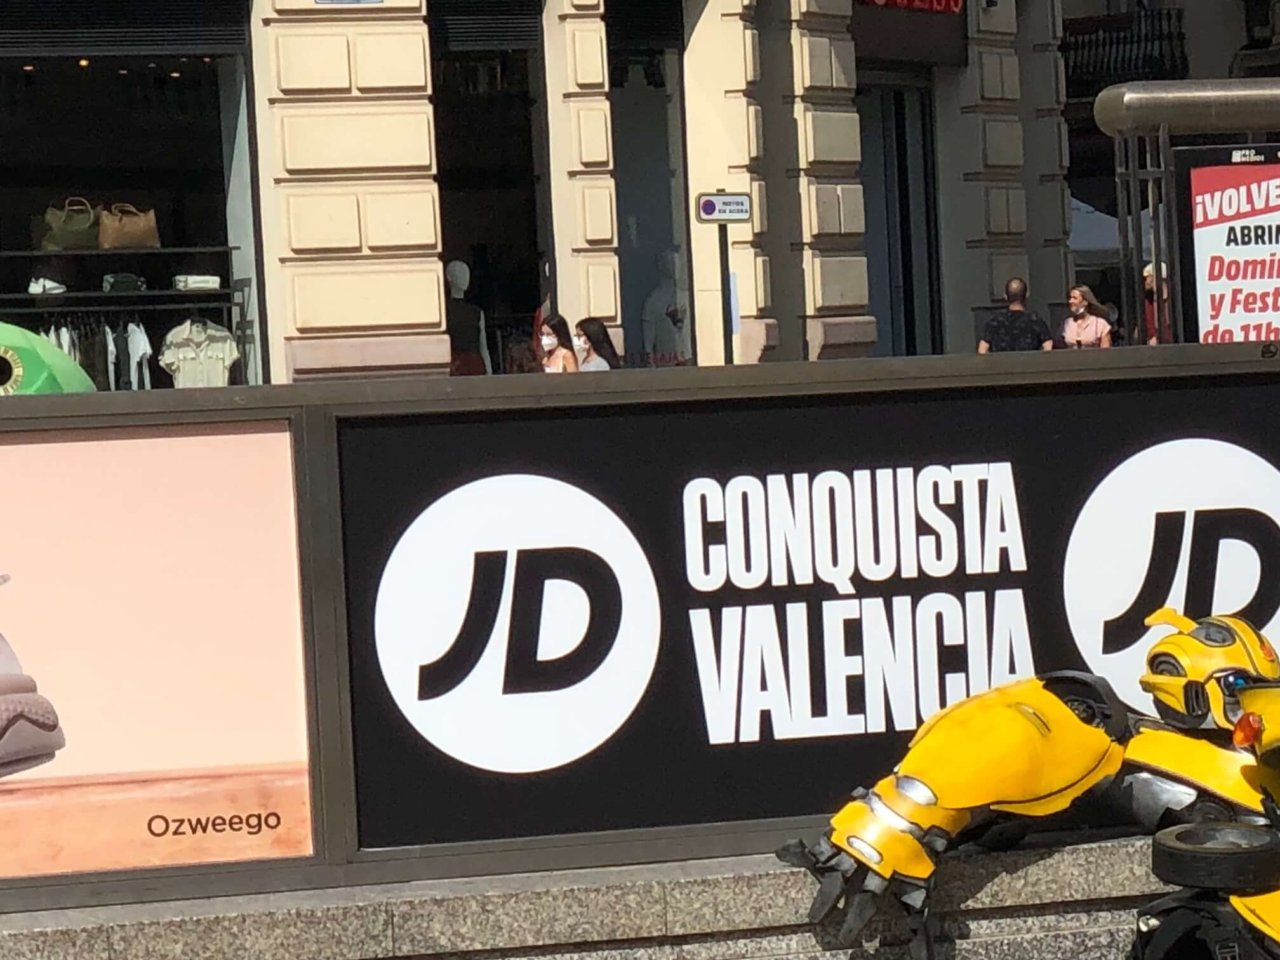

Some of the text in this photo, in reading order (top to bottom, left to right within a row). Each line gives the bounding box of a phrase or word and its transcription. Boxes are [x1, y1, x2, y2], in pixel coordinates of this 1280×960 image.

[1209, 293, 1226, 320] y
[683, 461, 1028, 595] CONQUISTA
[417, 546, 623, 701] JD
[147, 811, 281, 837] Ozweego
